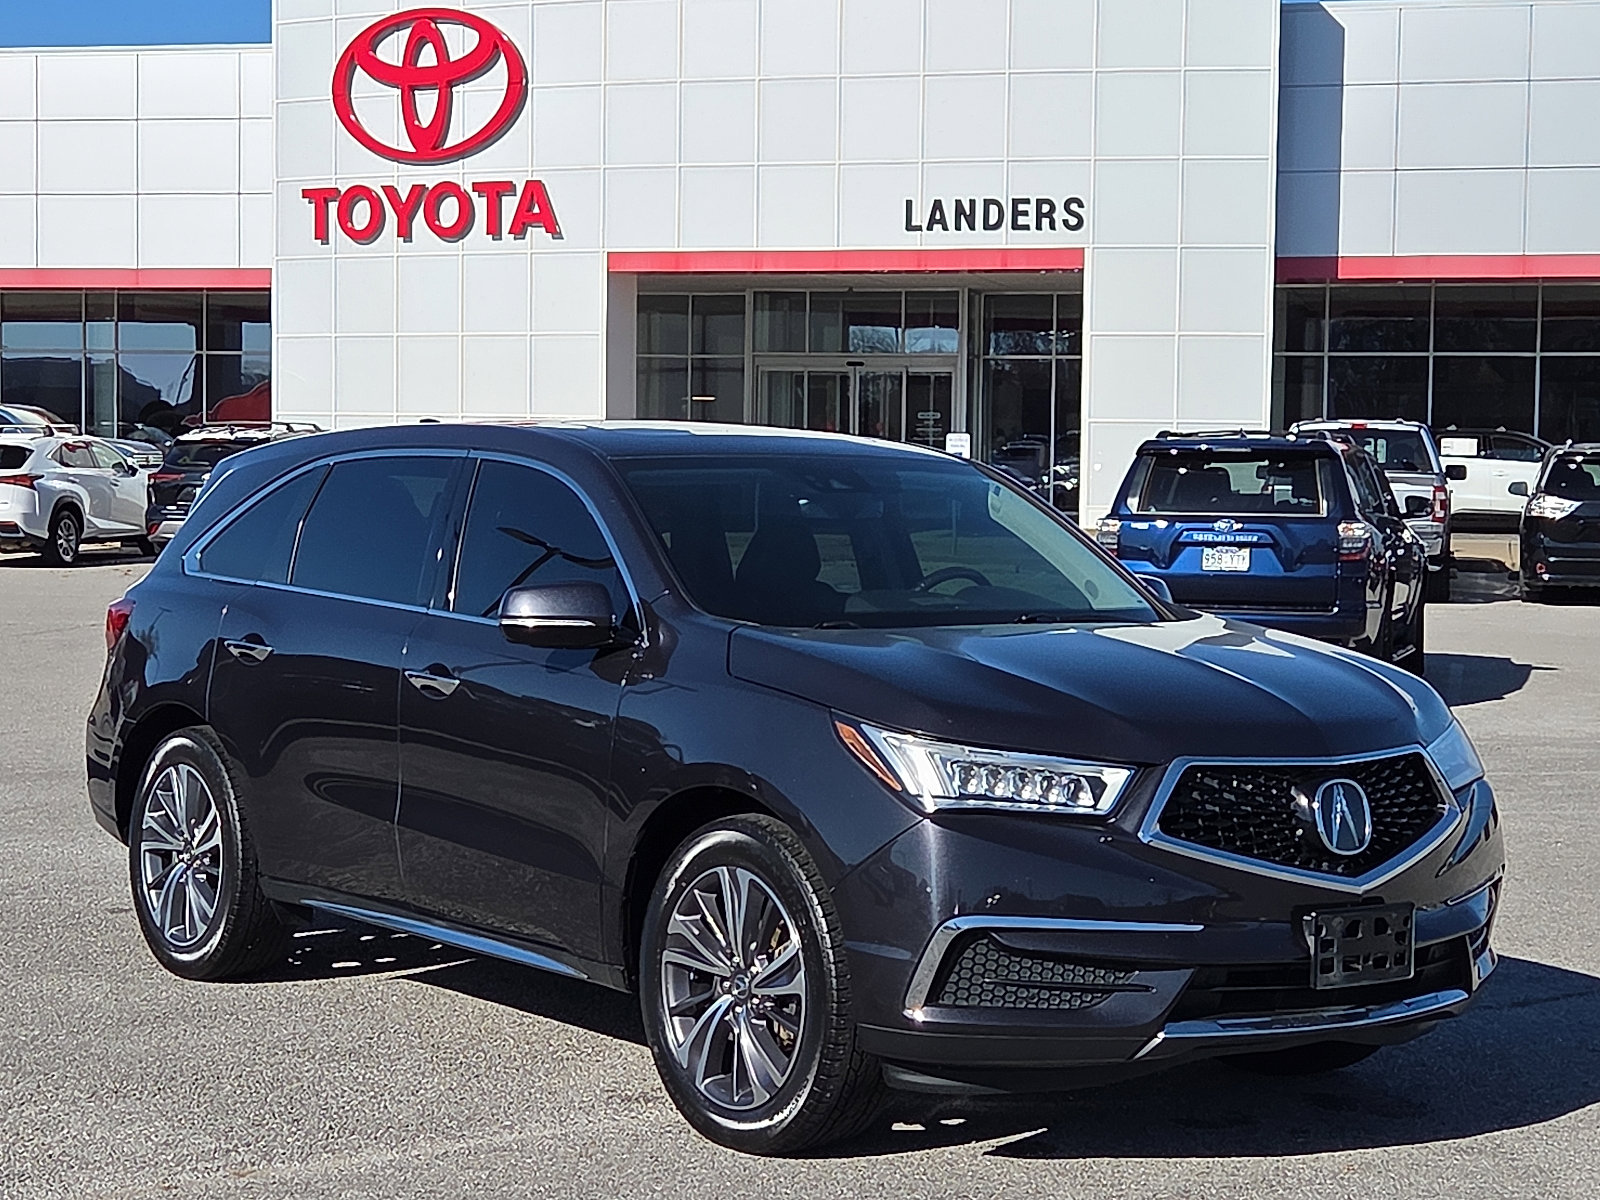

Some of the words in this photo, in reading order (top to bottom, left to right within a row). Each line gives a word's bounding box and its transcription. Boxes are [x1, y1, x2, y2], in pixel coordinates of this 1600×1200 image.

[302, 180, 562, 245] TOYOTA
[905, 197, 1085, 231] LANDERS
[1204, 553, 1223, 565] 958
